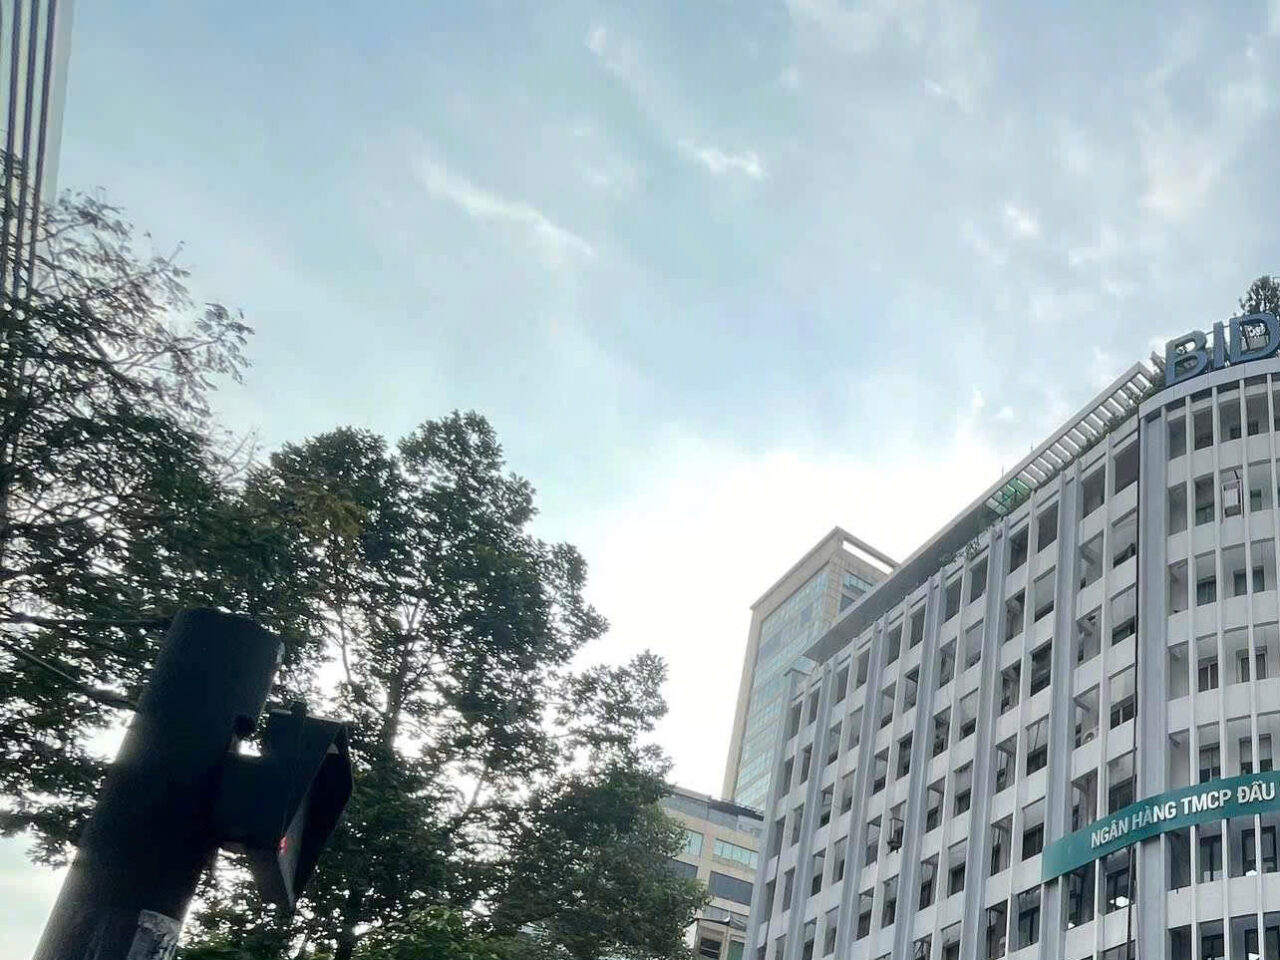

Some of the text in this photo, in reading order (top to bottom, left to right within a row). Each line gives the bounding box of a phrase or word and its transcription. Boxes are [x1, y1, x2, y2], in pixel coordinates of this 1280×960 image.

[1091, 813, 1129, 848] NGÂN
[1131, 801, 1177, 830] HÀNG
[1181, 789, 1232, 815] TMCP
[1237, 780, 1275, 804] ĐẦU
